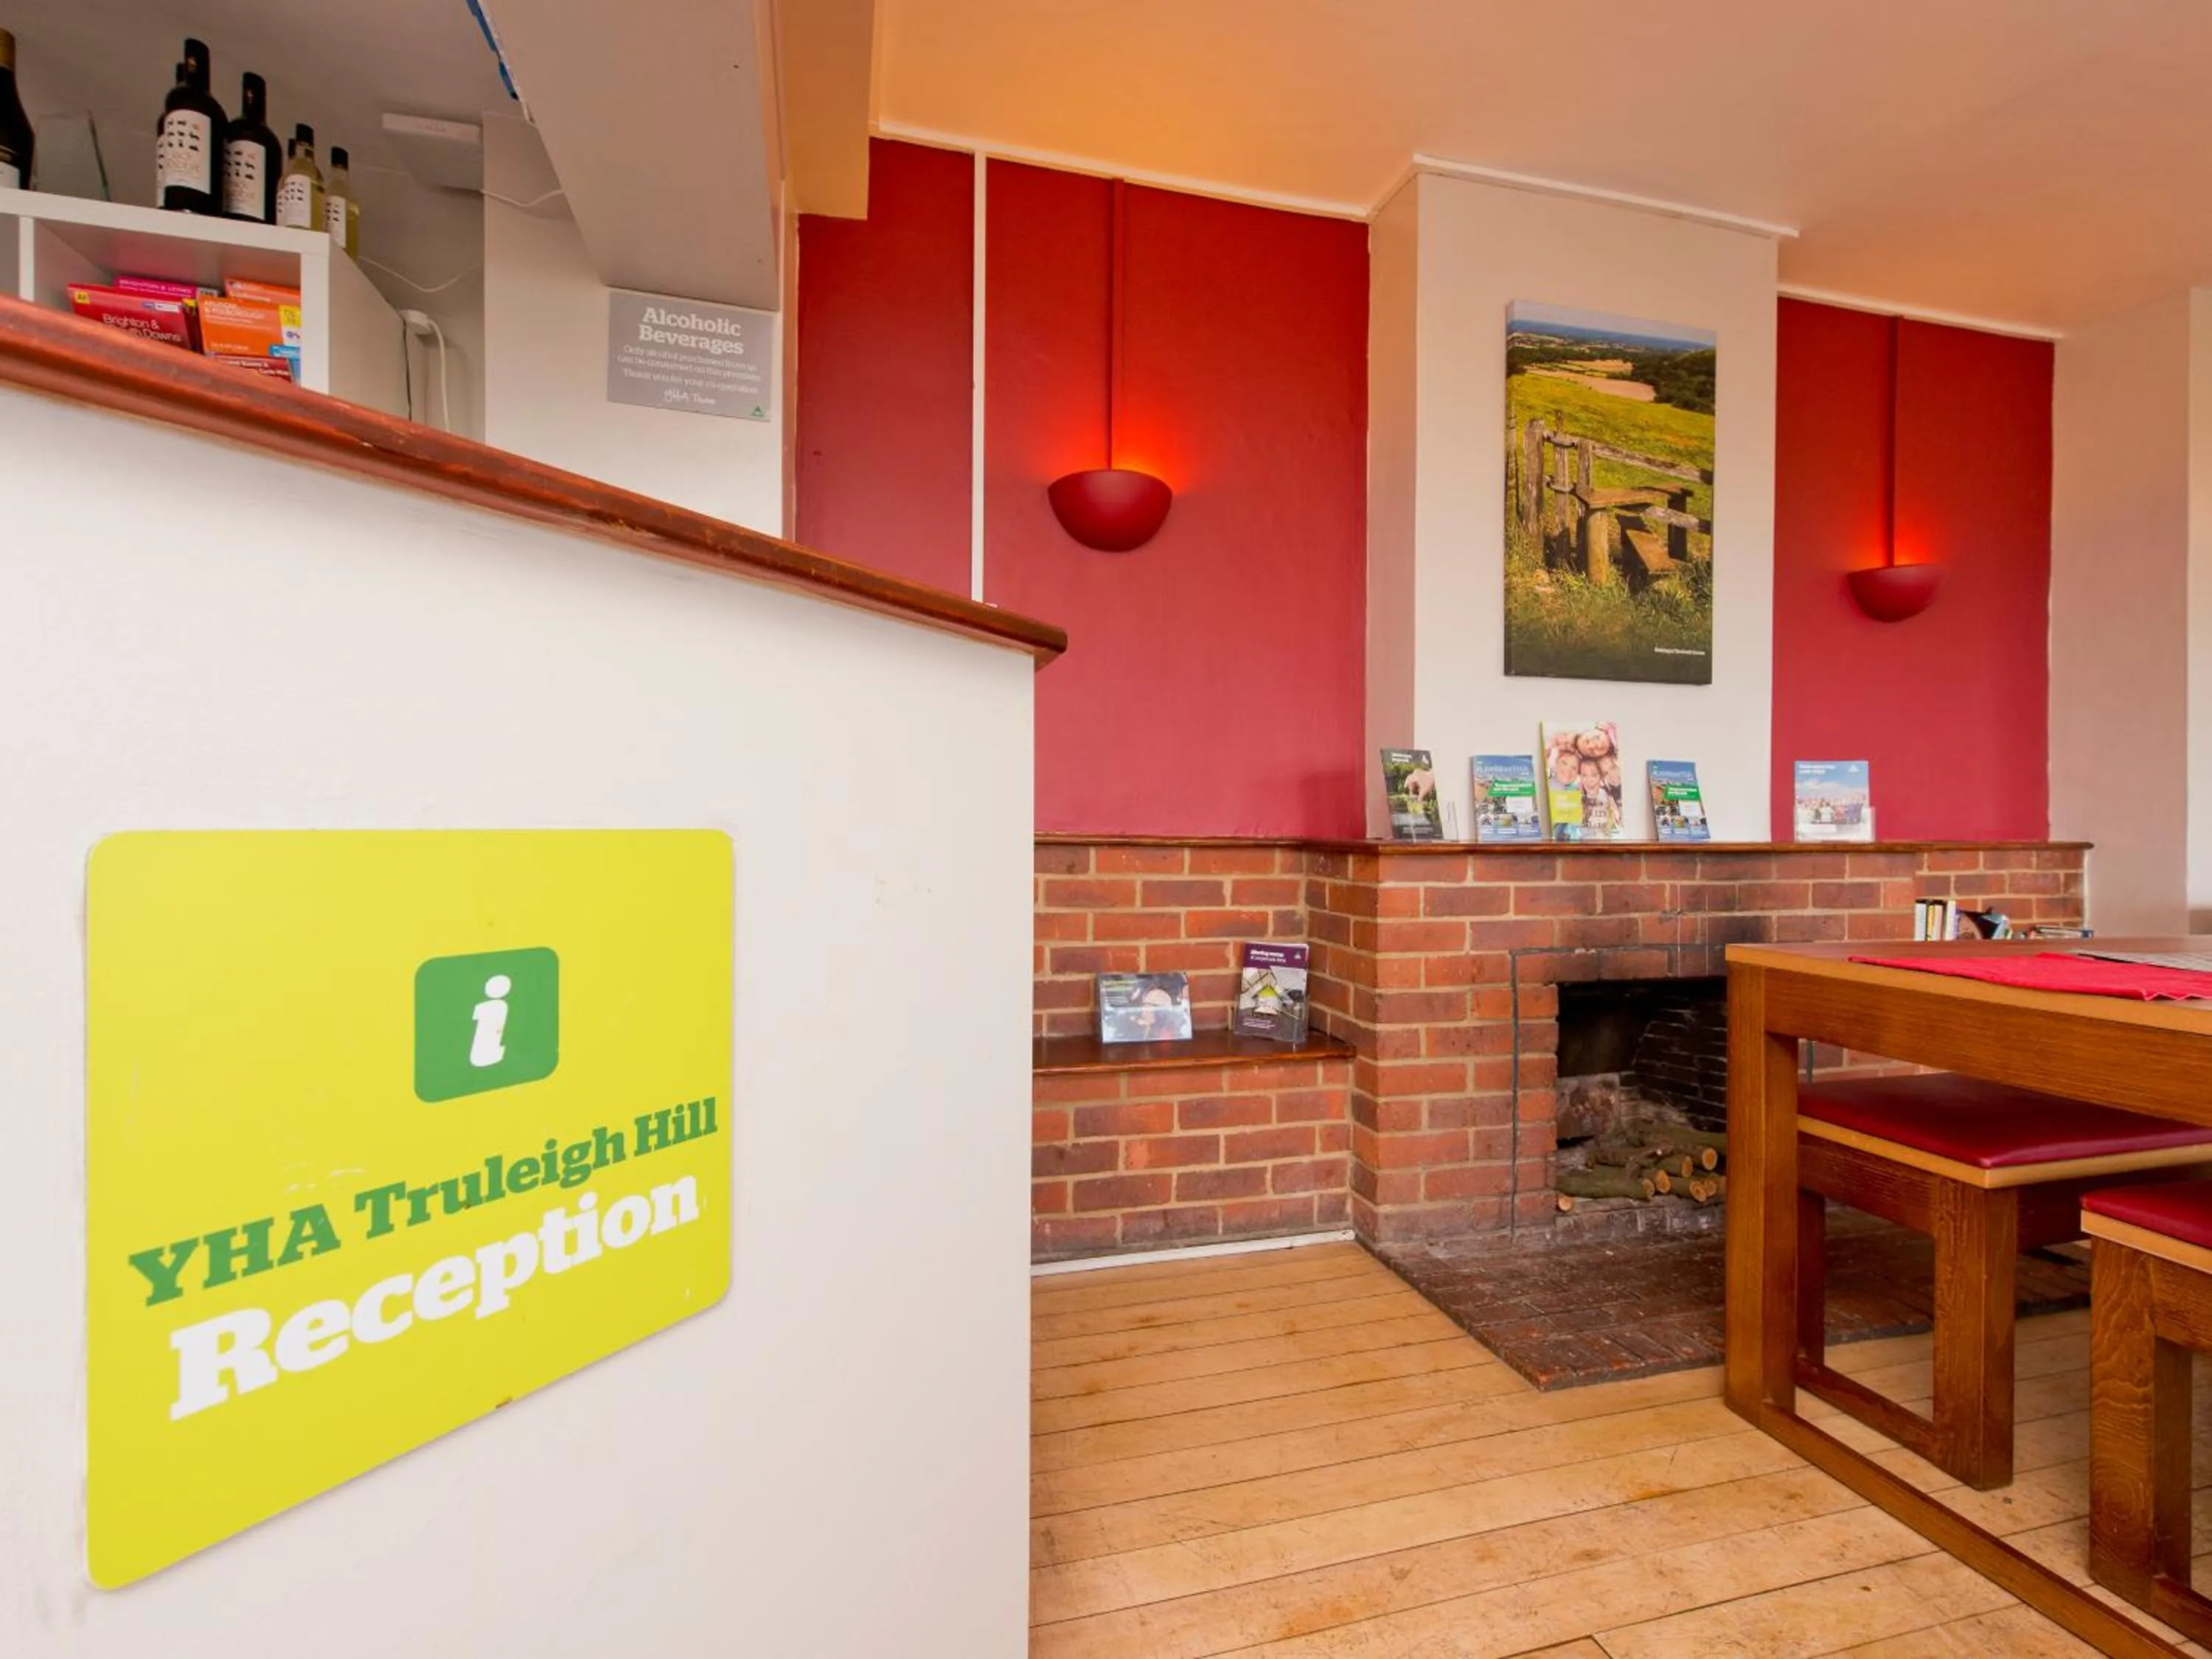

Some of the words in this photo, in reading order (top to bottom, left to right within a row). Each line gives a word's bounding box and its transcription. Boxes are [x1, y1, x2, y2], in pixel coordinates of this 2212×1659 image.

[102, 313, 150, 330] Brighton
[150, 319, 160, 330] &
[142, 328, 181, 342] Downs
[642, 307, 742, 337] Alcoholic
[637, 324, 744, 355] Beverages
[128, 1202, 341, 1308] YHA
[353, 1127, 625, 1242] Truleigh
[633, 1096, 718, 1156] Hill
[169, 1174, 701, 1422] Reception
